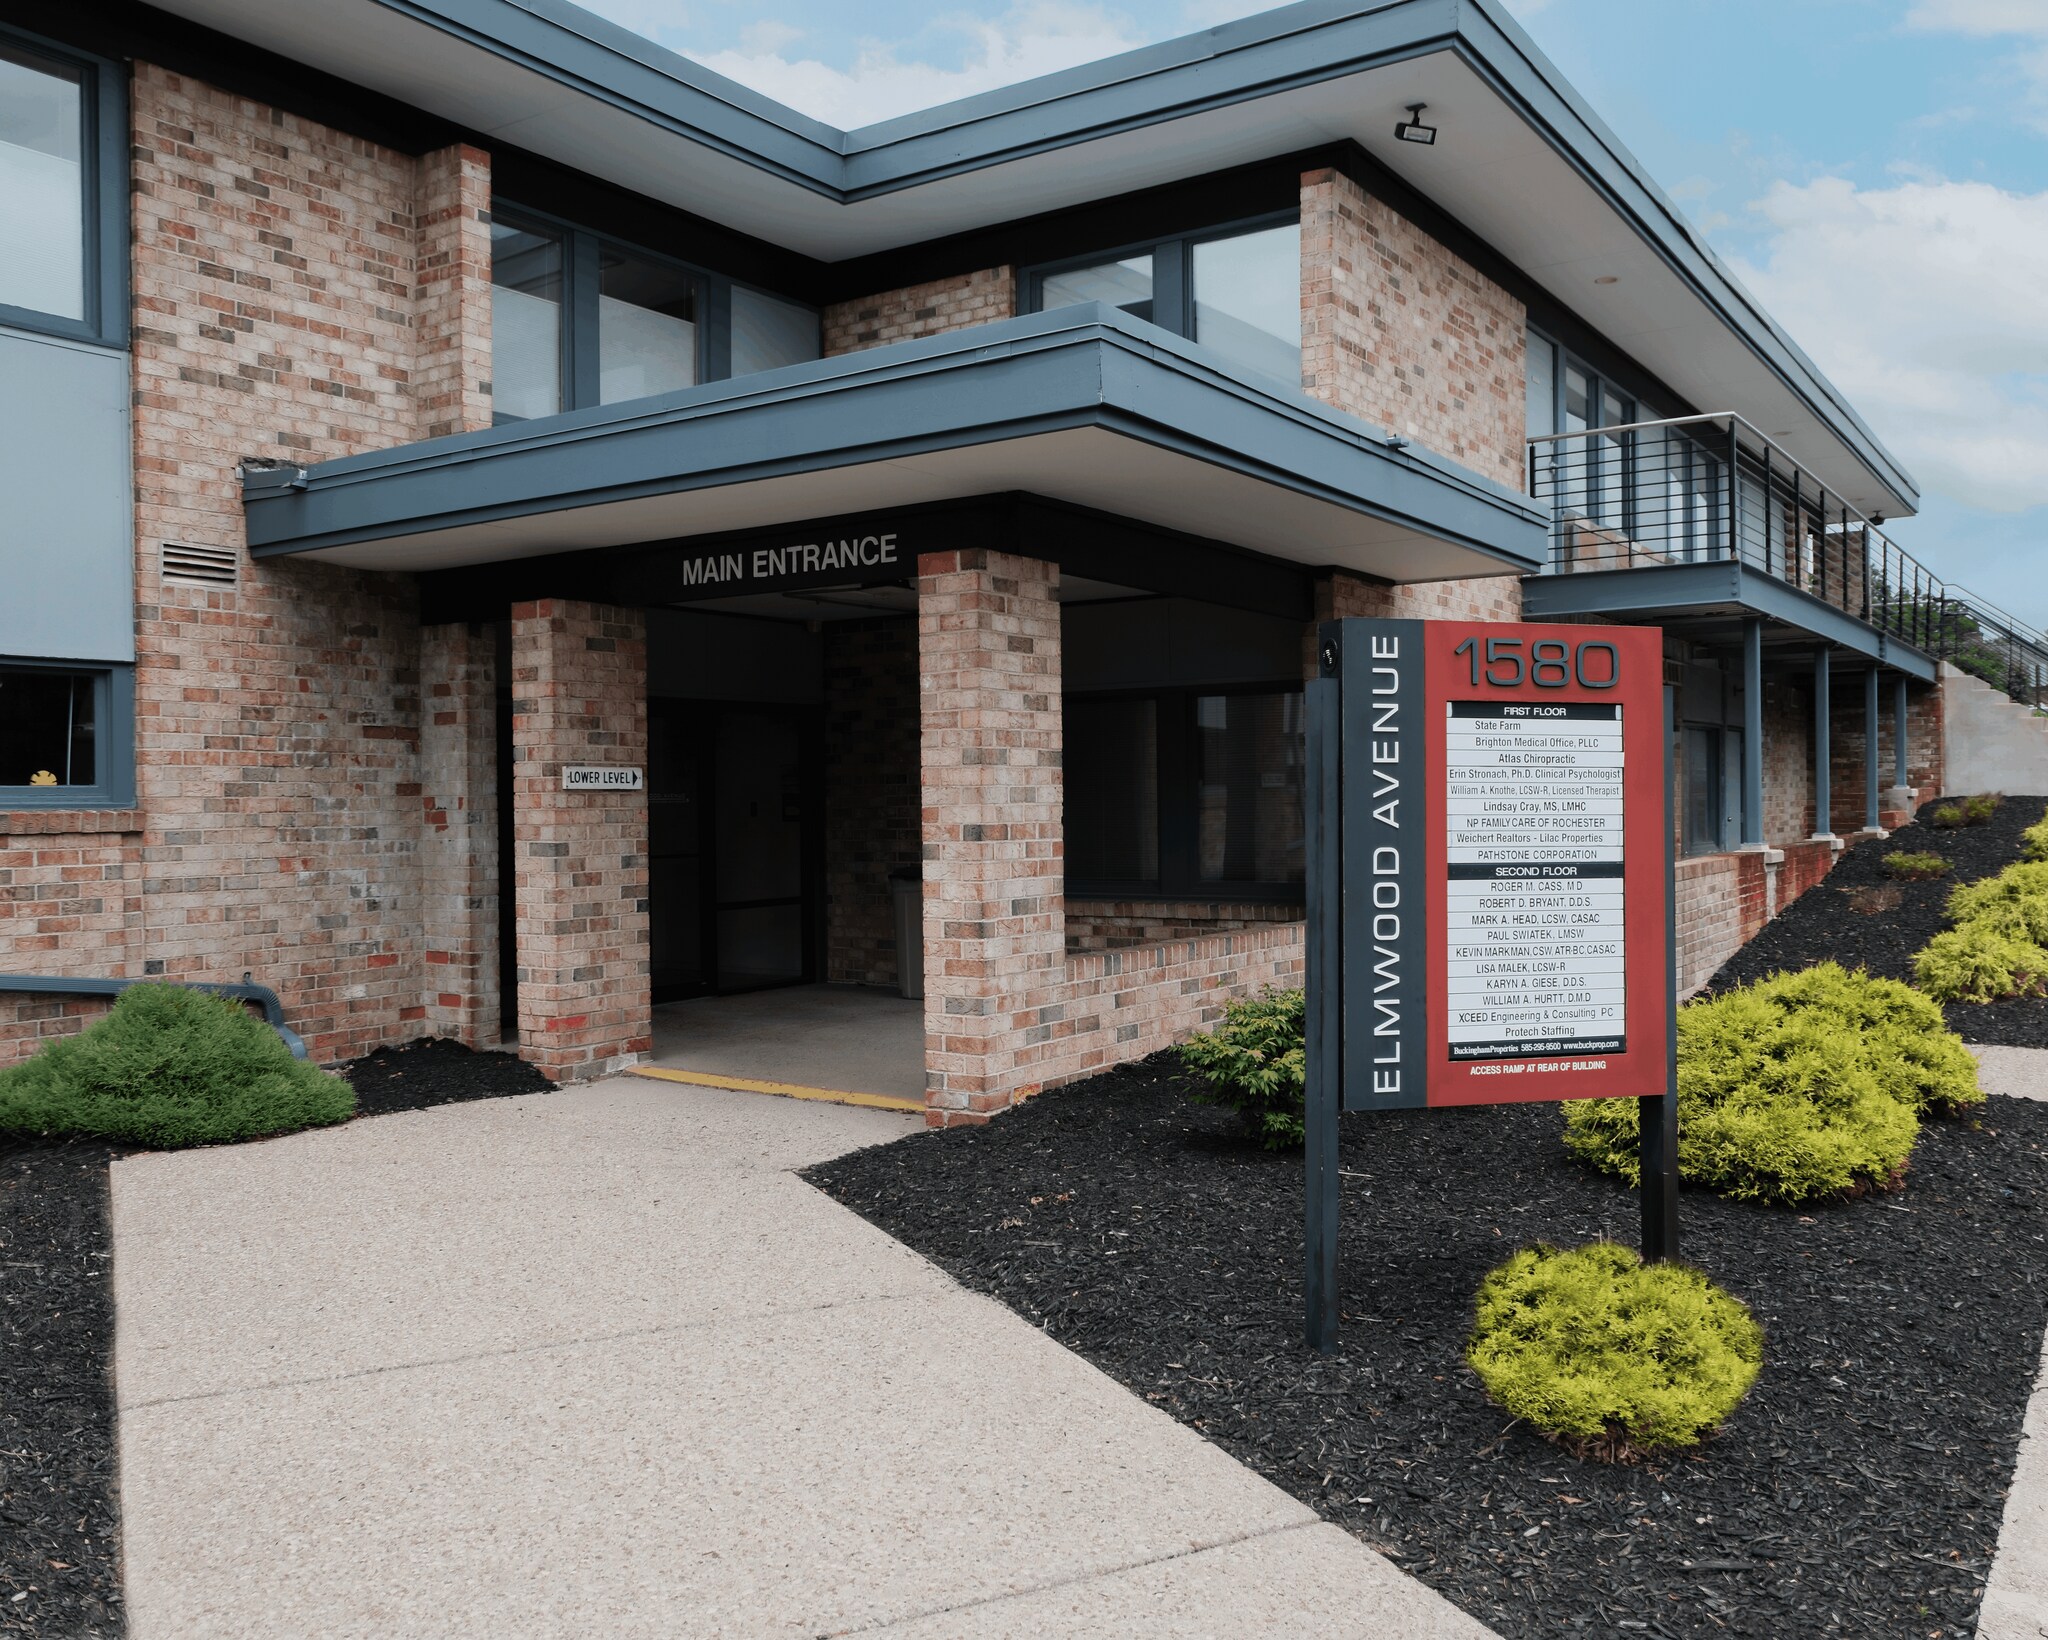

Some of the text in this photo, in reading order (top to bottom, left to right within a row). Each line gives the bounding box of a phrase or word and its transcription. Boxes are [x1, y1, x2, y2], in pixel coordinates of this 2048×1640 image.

[682, 533, 898, 586] MAIN ENTRANCE
[1455, 637, 1620, 688] 1580
[1504, 707, 1567, 716] FIRST FLOOR
[1475, 720, 1521, 731] State Farm
[1475, 737, 1599, 748] Brighton Medical Office, PLLC
[1498, 753, 1576, 764] Atlas Chiropractic
[570, 772, 630, 784] LOWER LEVEL
[1449, 769, 1620, 780] Erin Stronach, Ph.D. Clinical Psychologist
[1450, 785, 1619, 796] William A. Knothe, LCSW-R, Licensed Therapist
[1483, 802, 1586, 813] Lindsay Cray, MS, LMHC
[1466, 818, 1605, 827] NP FAMILY CARE OF ROCHESTER
[1457, 833, 1494, 842] Weichert
[1497, 833, 1531, 842] Realtors
[1539, 833, 1559, 843] Lilac
[1562, 833, 1603, 844] Properties
[1478, 850, 1597, 860] PATHSTONE CORPORATION
[1371, 635, 1401, 1095] ELMWOOD AVENUE
[1496, 867, 1577, 876] SECOND FLOOR
[1491, 882, 1523, 891] ROGER
[1526, 882, 1535, 891] M.
[1479, 899, 1515, 908] ROBERT
[1518, 898, 1526, 907] D.
[1569, 897, 1593, 906] D.D.S.
[1472, 915, 1498, 925] MARK
[1501, 915, 1509, 924] A.
[1571, 913, 1600, 923] CASAC
[1487, 931, 1509, 940] PAUL
[1558, 929, 1585, 939] LMSW
[1456, 947, 1482, 957] KEVIN
[1477, 962, 1566, 974] LISA MALEK, LCSW-R
[1486, 979, 1518, 989] KARYN
[1521, 979, 1529, 988] A.
[1563, 977, 1587, 987] D.D.S.
[1483, 995, 1520, 1005] WILLIAM
[1523, 995, 1531, 1004] A.
[1459, 1008, 1613, 1023] XCEED Engineering & Consulting PC
[1505, 1026, 1575, 1037] Protech Staffing
[1521, 1042, 1561, 1051] 585-295-9500
[1563, 1041, 1619, 1050] www.buckprop.com
[1470, 1061, 1606, 1075] ACCESS RAMP AT REAR OF BUILDING
